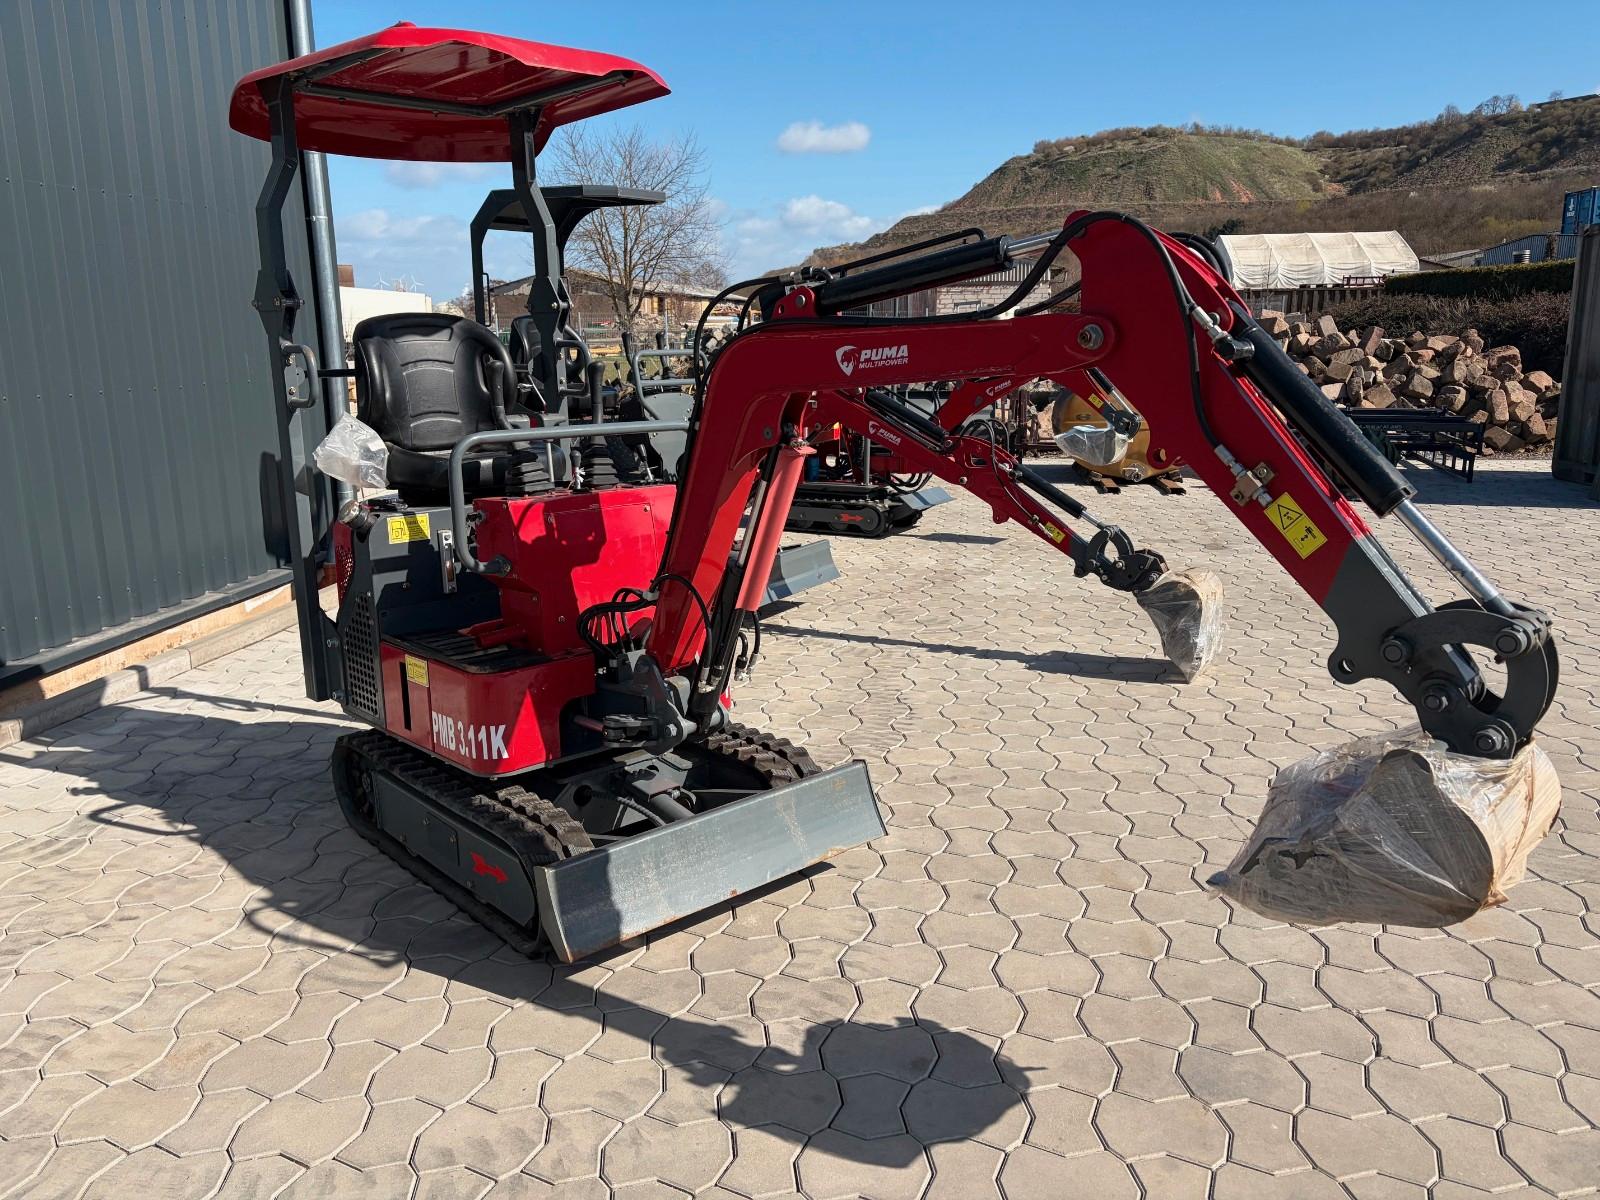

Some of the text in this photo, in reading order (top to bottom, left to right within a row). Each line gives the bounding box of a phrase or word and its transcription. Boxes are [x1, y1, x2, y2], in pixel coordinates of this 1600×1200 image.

[860, 344, 909, 362] PUMA
[859, 357, 909, 369] MULTIPOWER
[878, 428, 902, 443] PUMA
[431, 710, 510, 760] PMB 3.11K
